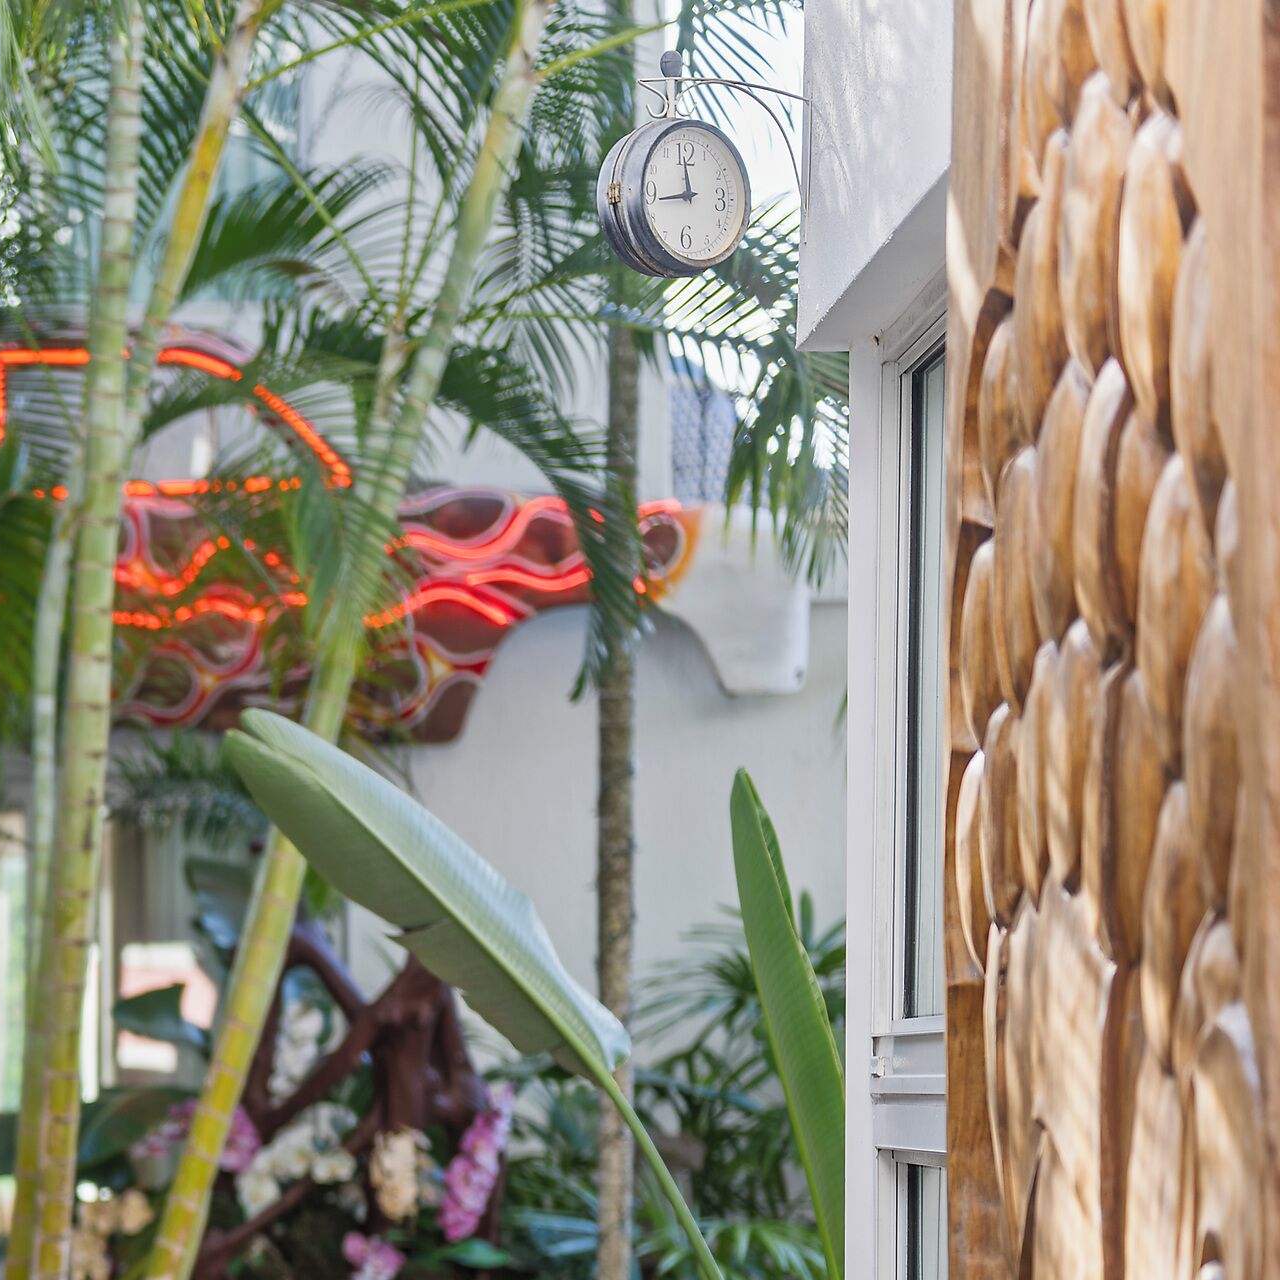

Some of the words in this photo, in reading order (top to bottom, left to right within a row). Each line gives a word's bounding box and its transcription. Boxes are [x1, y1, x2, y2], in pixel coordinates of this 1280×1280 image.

[676, 142, 695, 167] 12
[645, 180, 657, 205] 9
[714, 187, 726, 212] 3
[680, 225, 692, 250] 6
